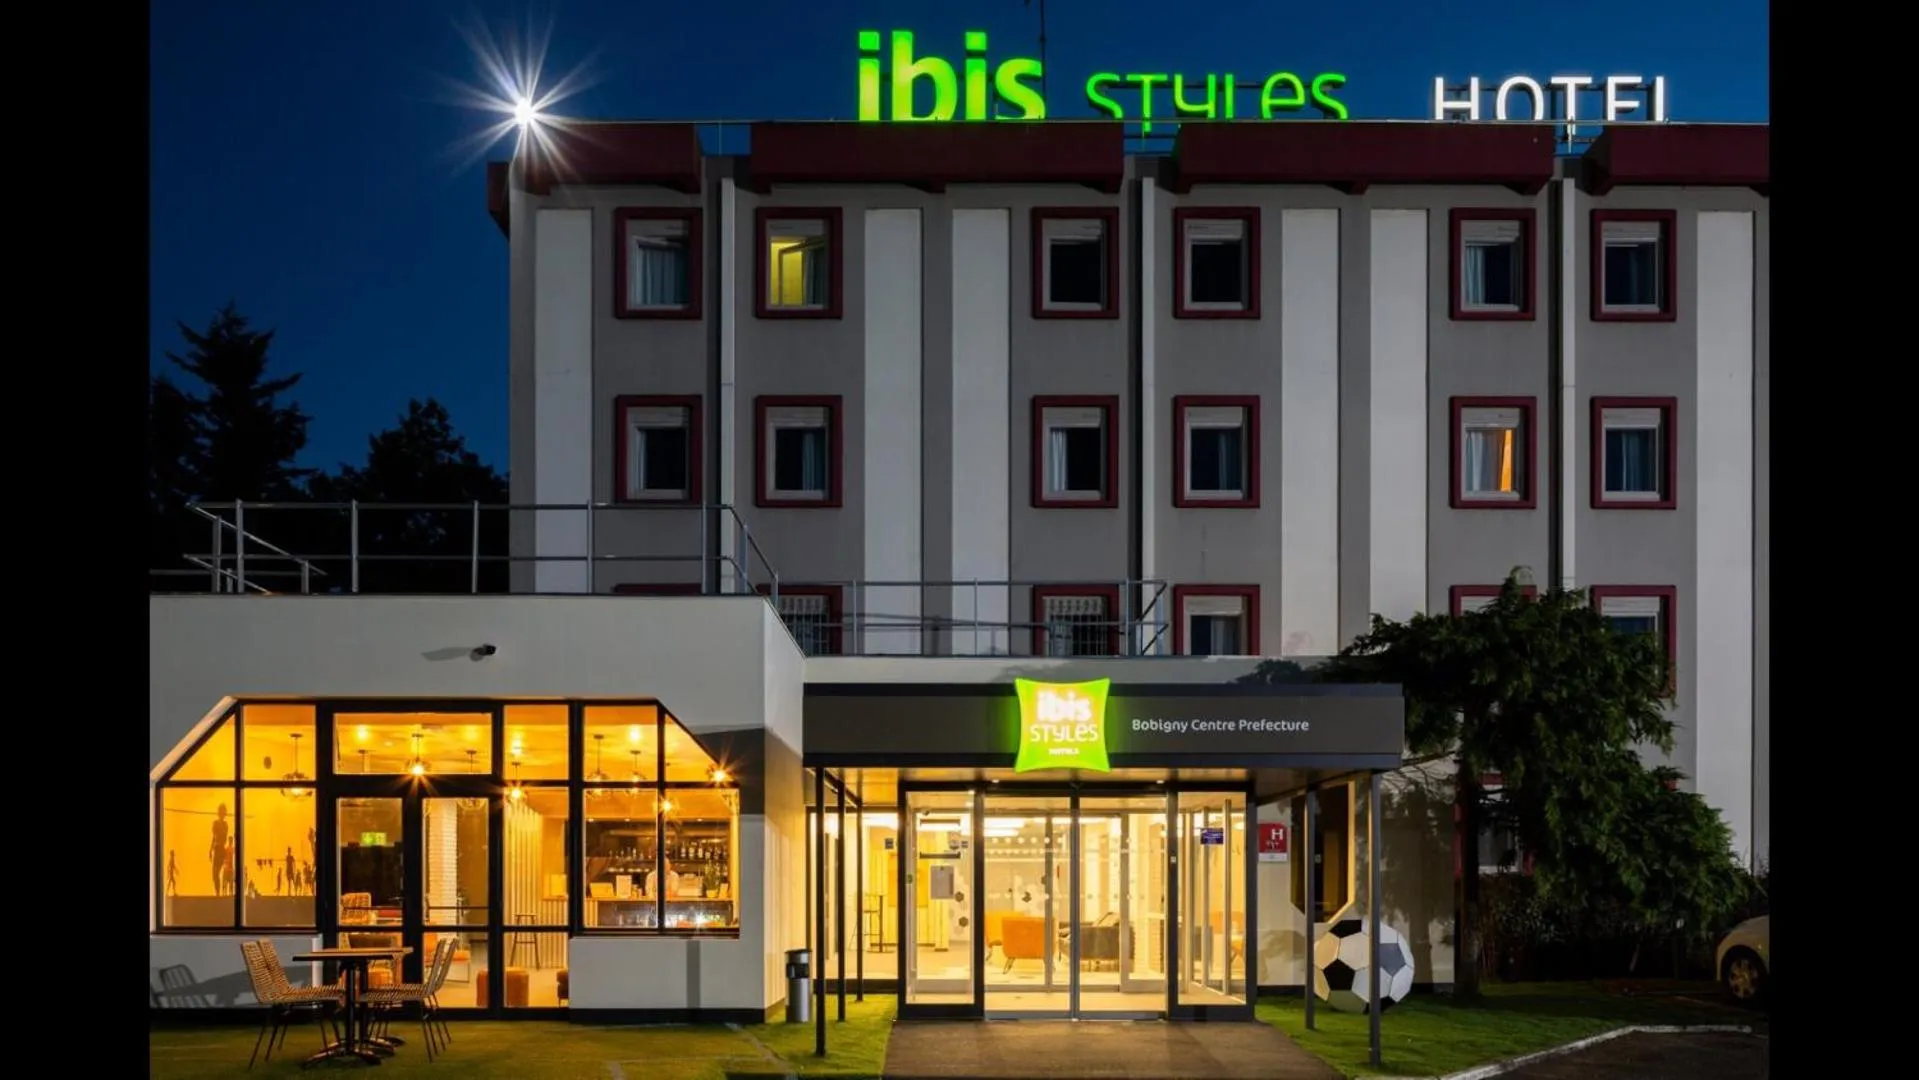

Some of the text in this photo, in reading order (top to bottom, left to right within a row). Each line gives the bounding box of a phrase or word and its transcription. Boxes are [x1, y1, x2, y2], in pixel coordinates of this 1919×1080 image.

[859, 31, 1046, 120] ibis
[1036, 690, 1092, 722] ibis
[1132, 719, 1309, 733] Bobigny Centre Prefecture
[1271, 828, 1284, 840] H
